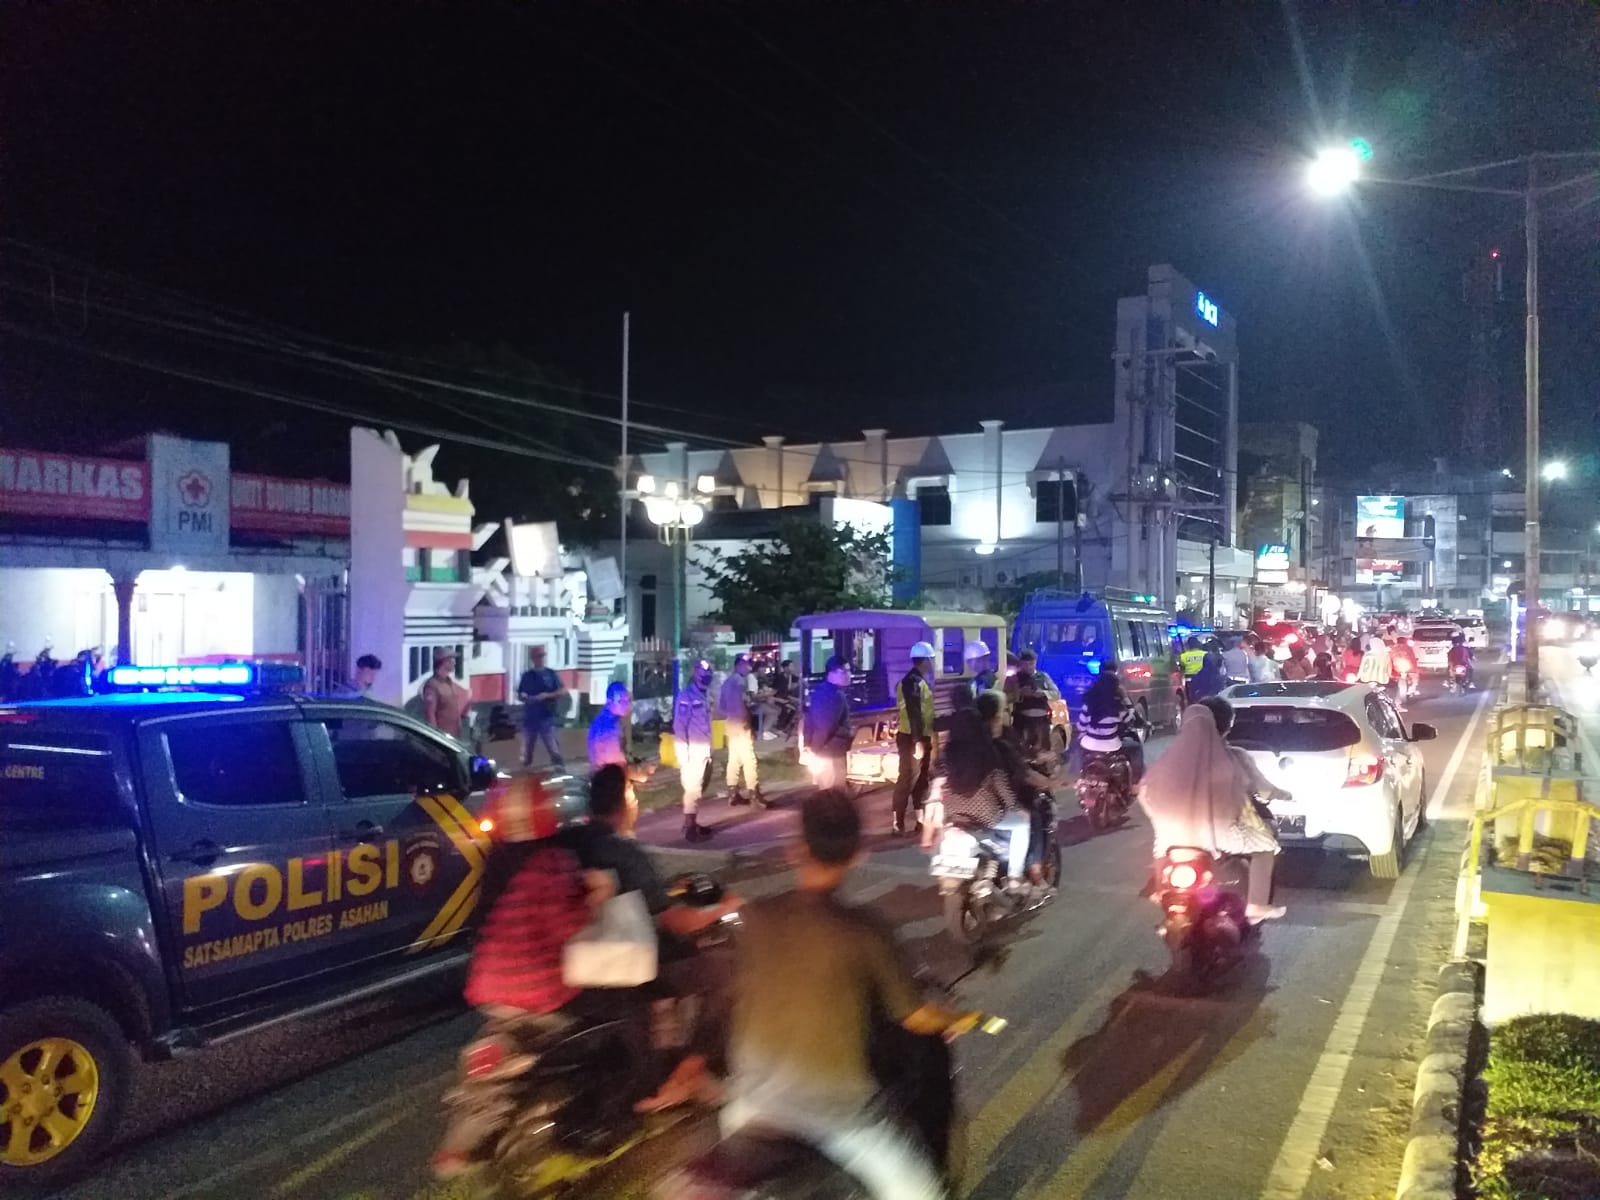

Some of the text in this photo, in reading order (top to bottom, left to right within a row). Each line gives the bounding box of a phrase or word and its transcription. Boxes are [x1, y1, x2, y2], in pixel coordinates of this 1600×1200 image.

[178, 510, 213, 533] PMI
[182, 838, 400, 934] POLISI
[183, 900, 390, 969] SATSAMAPTA POLRES ASAHAN
